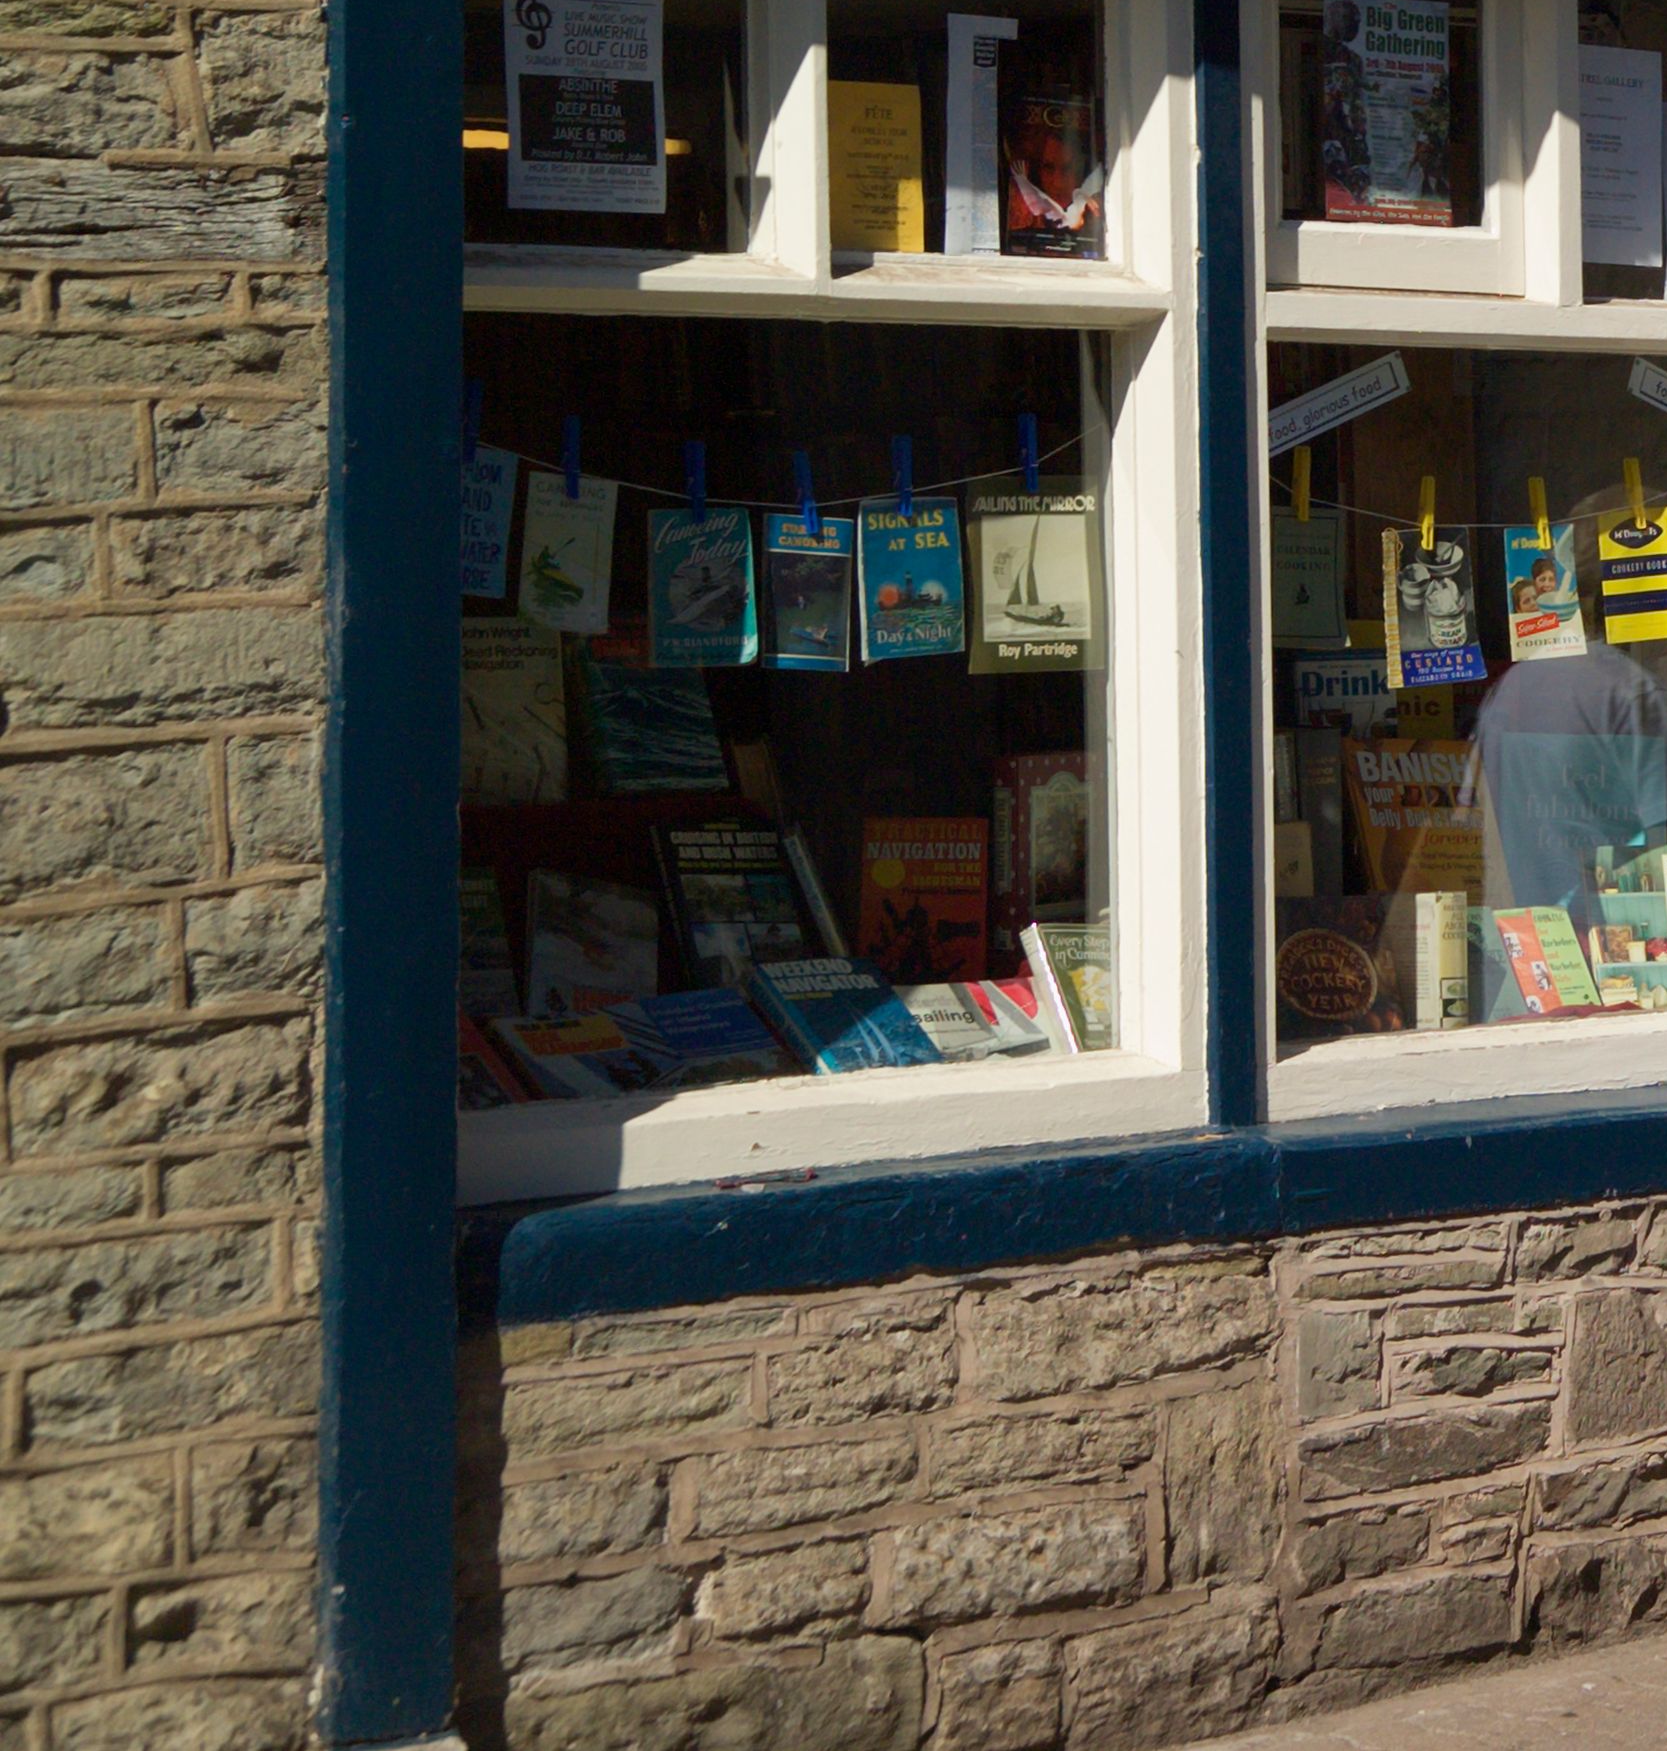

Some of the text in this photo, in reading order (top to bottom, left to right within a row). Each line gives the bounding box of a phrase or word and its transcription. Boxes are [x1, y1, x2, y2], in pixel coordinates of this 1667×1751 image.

[1366, 6, 1446, 34] Big Green
[563, 22, 648, 42] SUMMERHILL
[564, 39, 649, 60] GOLF CLUB
[1365, 30, 1446, 61] Gathering
[558, 78, 619, 94] ABSINTHE
[1603, 75, 1643, 89] GALLERY
[555, 100, 622, 118] DEEP ELEM
[552, 127, 583, 141] JAKE
[600, 129, 626, 143] ROB
[1302, 394, 1350, 430] glorious
[1351, 377, 1382, 402] food
[972, 495, 1097, 513] SAILING THE MIRROR
[867, 508, 945, 531] SIGNALS
[655, 511, 740, 555] Canoeing
[888, 531, 950, 552] AT SEA
[685, 535, 748, 569] Today
[1611, 561, 1644, 575] COOKERY
[876, 628, 906, 645] Day
[914, 624, 952, 642] Night
[1516, 635, 1583, 649] COOKERY
[998, 642, 1079, 659] Roy Partridge
[1405, 653, 1474, 669] CUSTARD
[1301, 669, 1390, 698] Drink
[1356, 750, 1471, 784] BANISH
[1364, 786, 1395, 805] your
[874, 824, 981, 841] PRACTICAL
[866, 842, 981, 860] NAVIGATION
[957, 862, 981, 873] THE
[760, 958, 854, 978] WEEKEND
[1303, 951, 1346, 970] NEW
[769, 973, 881, 994] NAVIGATOR
[1290, 973, 1366, 994] COOKERY
[1307, 992, 1355, 1010] YEAR
[912, 1009, 975, 1024] sailing
